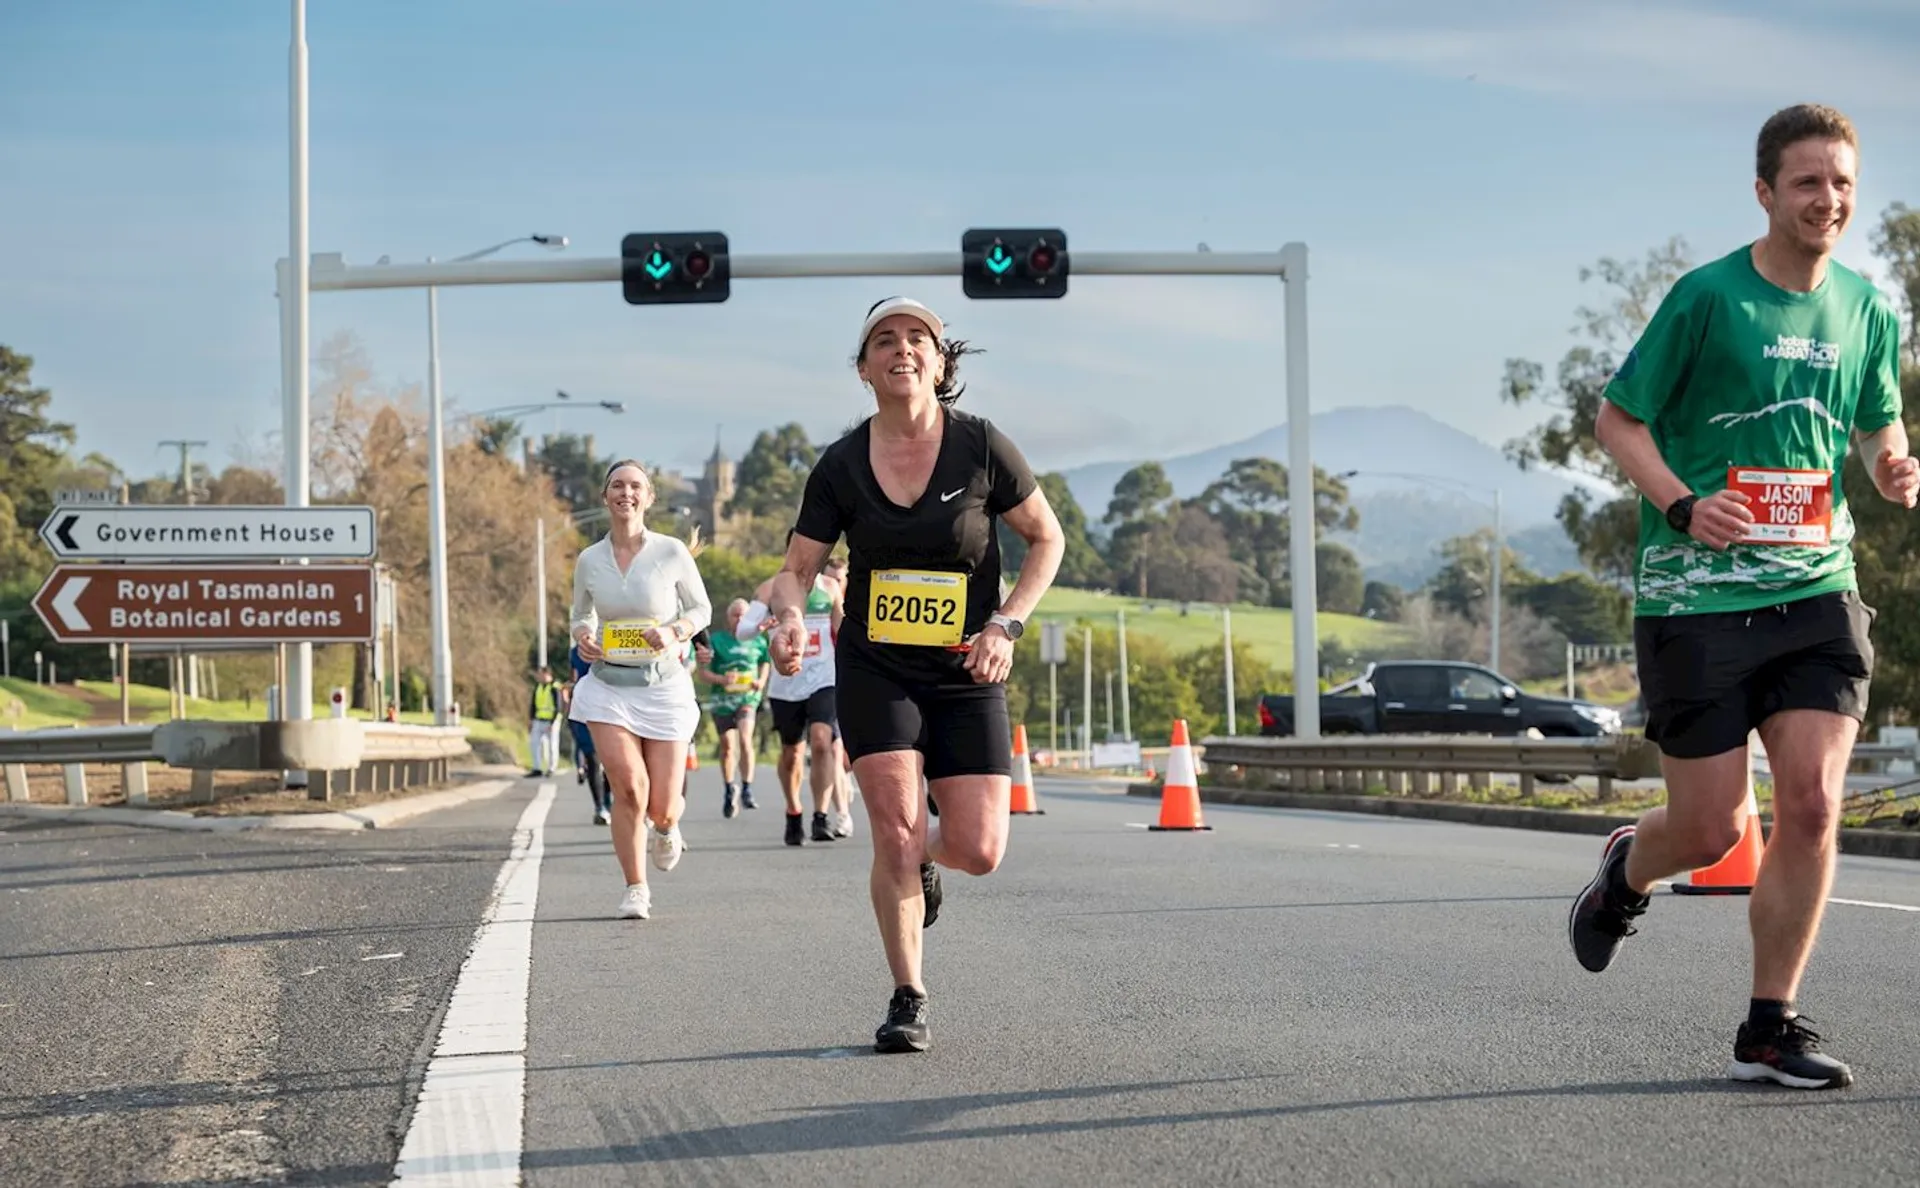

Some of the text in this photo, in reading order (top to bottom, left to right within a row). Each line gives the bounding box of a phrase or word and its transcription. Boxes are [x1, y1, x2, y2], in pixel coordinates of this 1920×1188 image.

[1759, 485, 1813, 504] JASON
[1768, 504, 1804, 524] 1061
[97, 523, 357, 542] Government House 1
[118, 579, 335, 604] Royal Tasmanian
[354, 592, 363, 614] 1
[876, 594, 956, 625] 62052
[110, 606, 341, 628] Botanical Gardens
[619, 638, 643, 648] 2290
